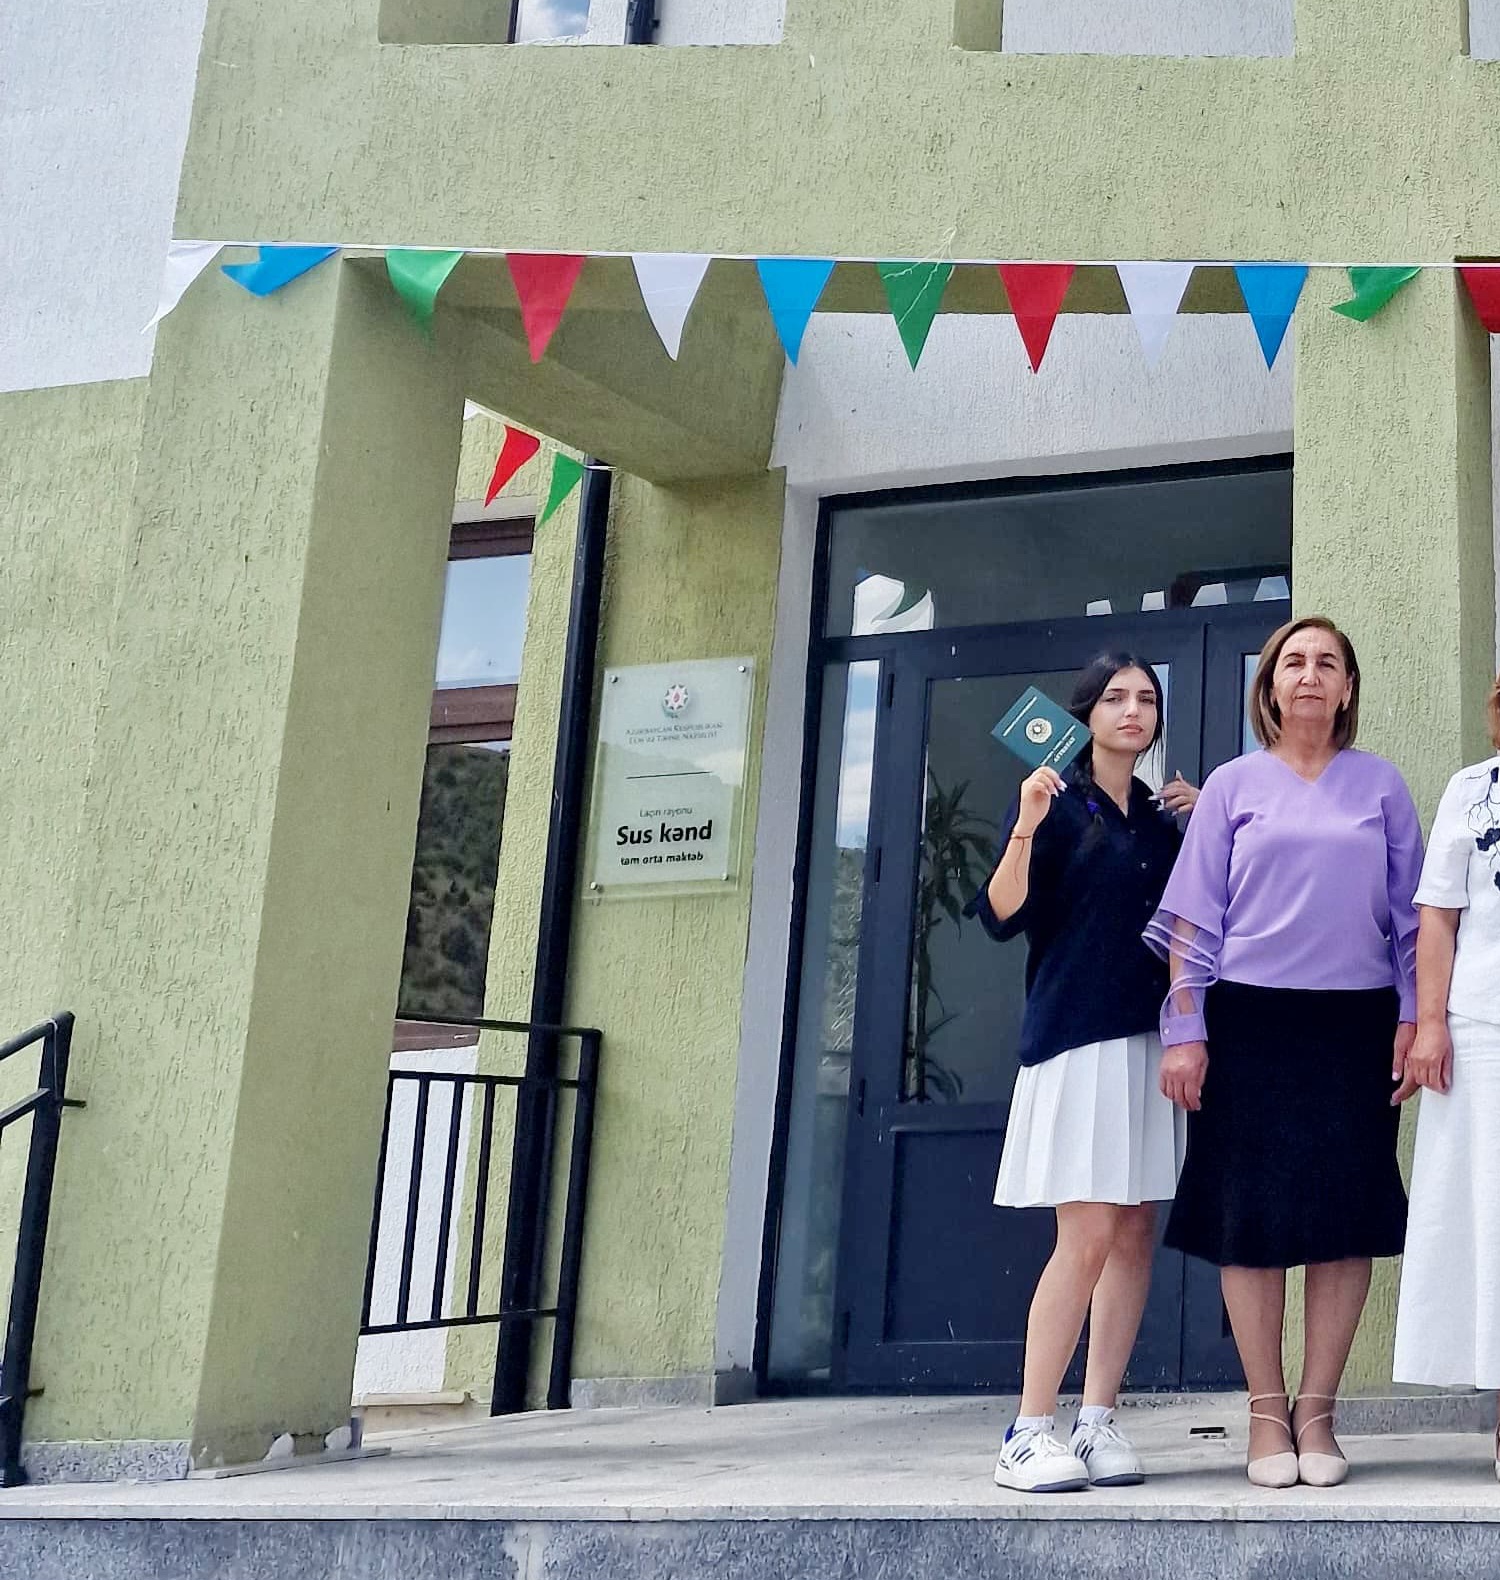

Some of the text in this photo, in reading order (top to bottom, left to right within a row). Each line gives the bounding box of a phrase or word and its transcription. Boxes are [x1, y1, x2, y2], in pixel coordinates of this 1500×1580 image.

[616, 819, 713, 846] Sus kənd
[642, 855, 663, 865] orta
